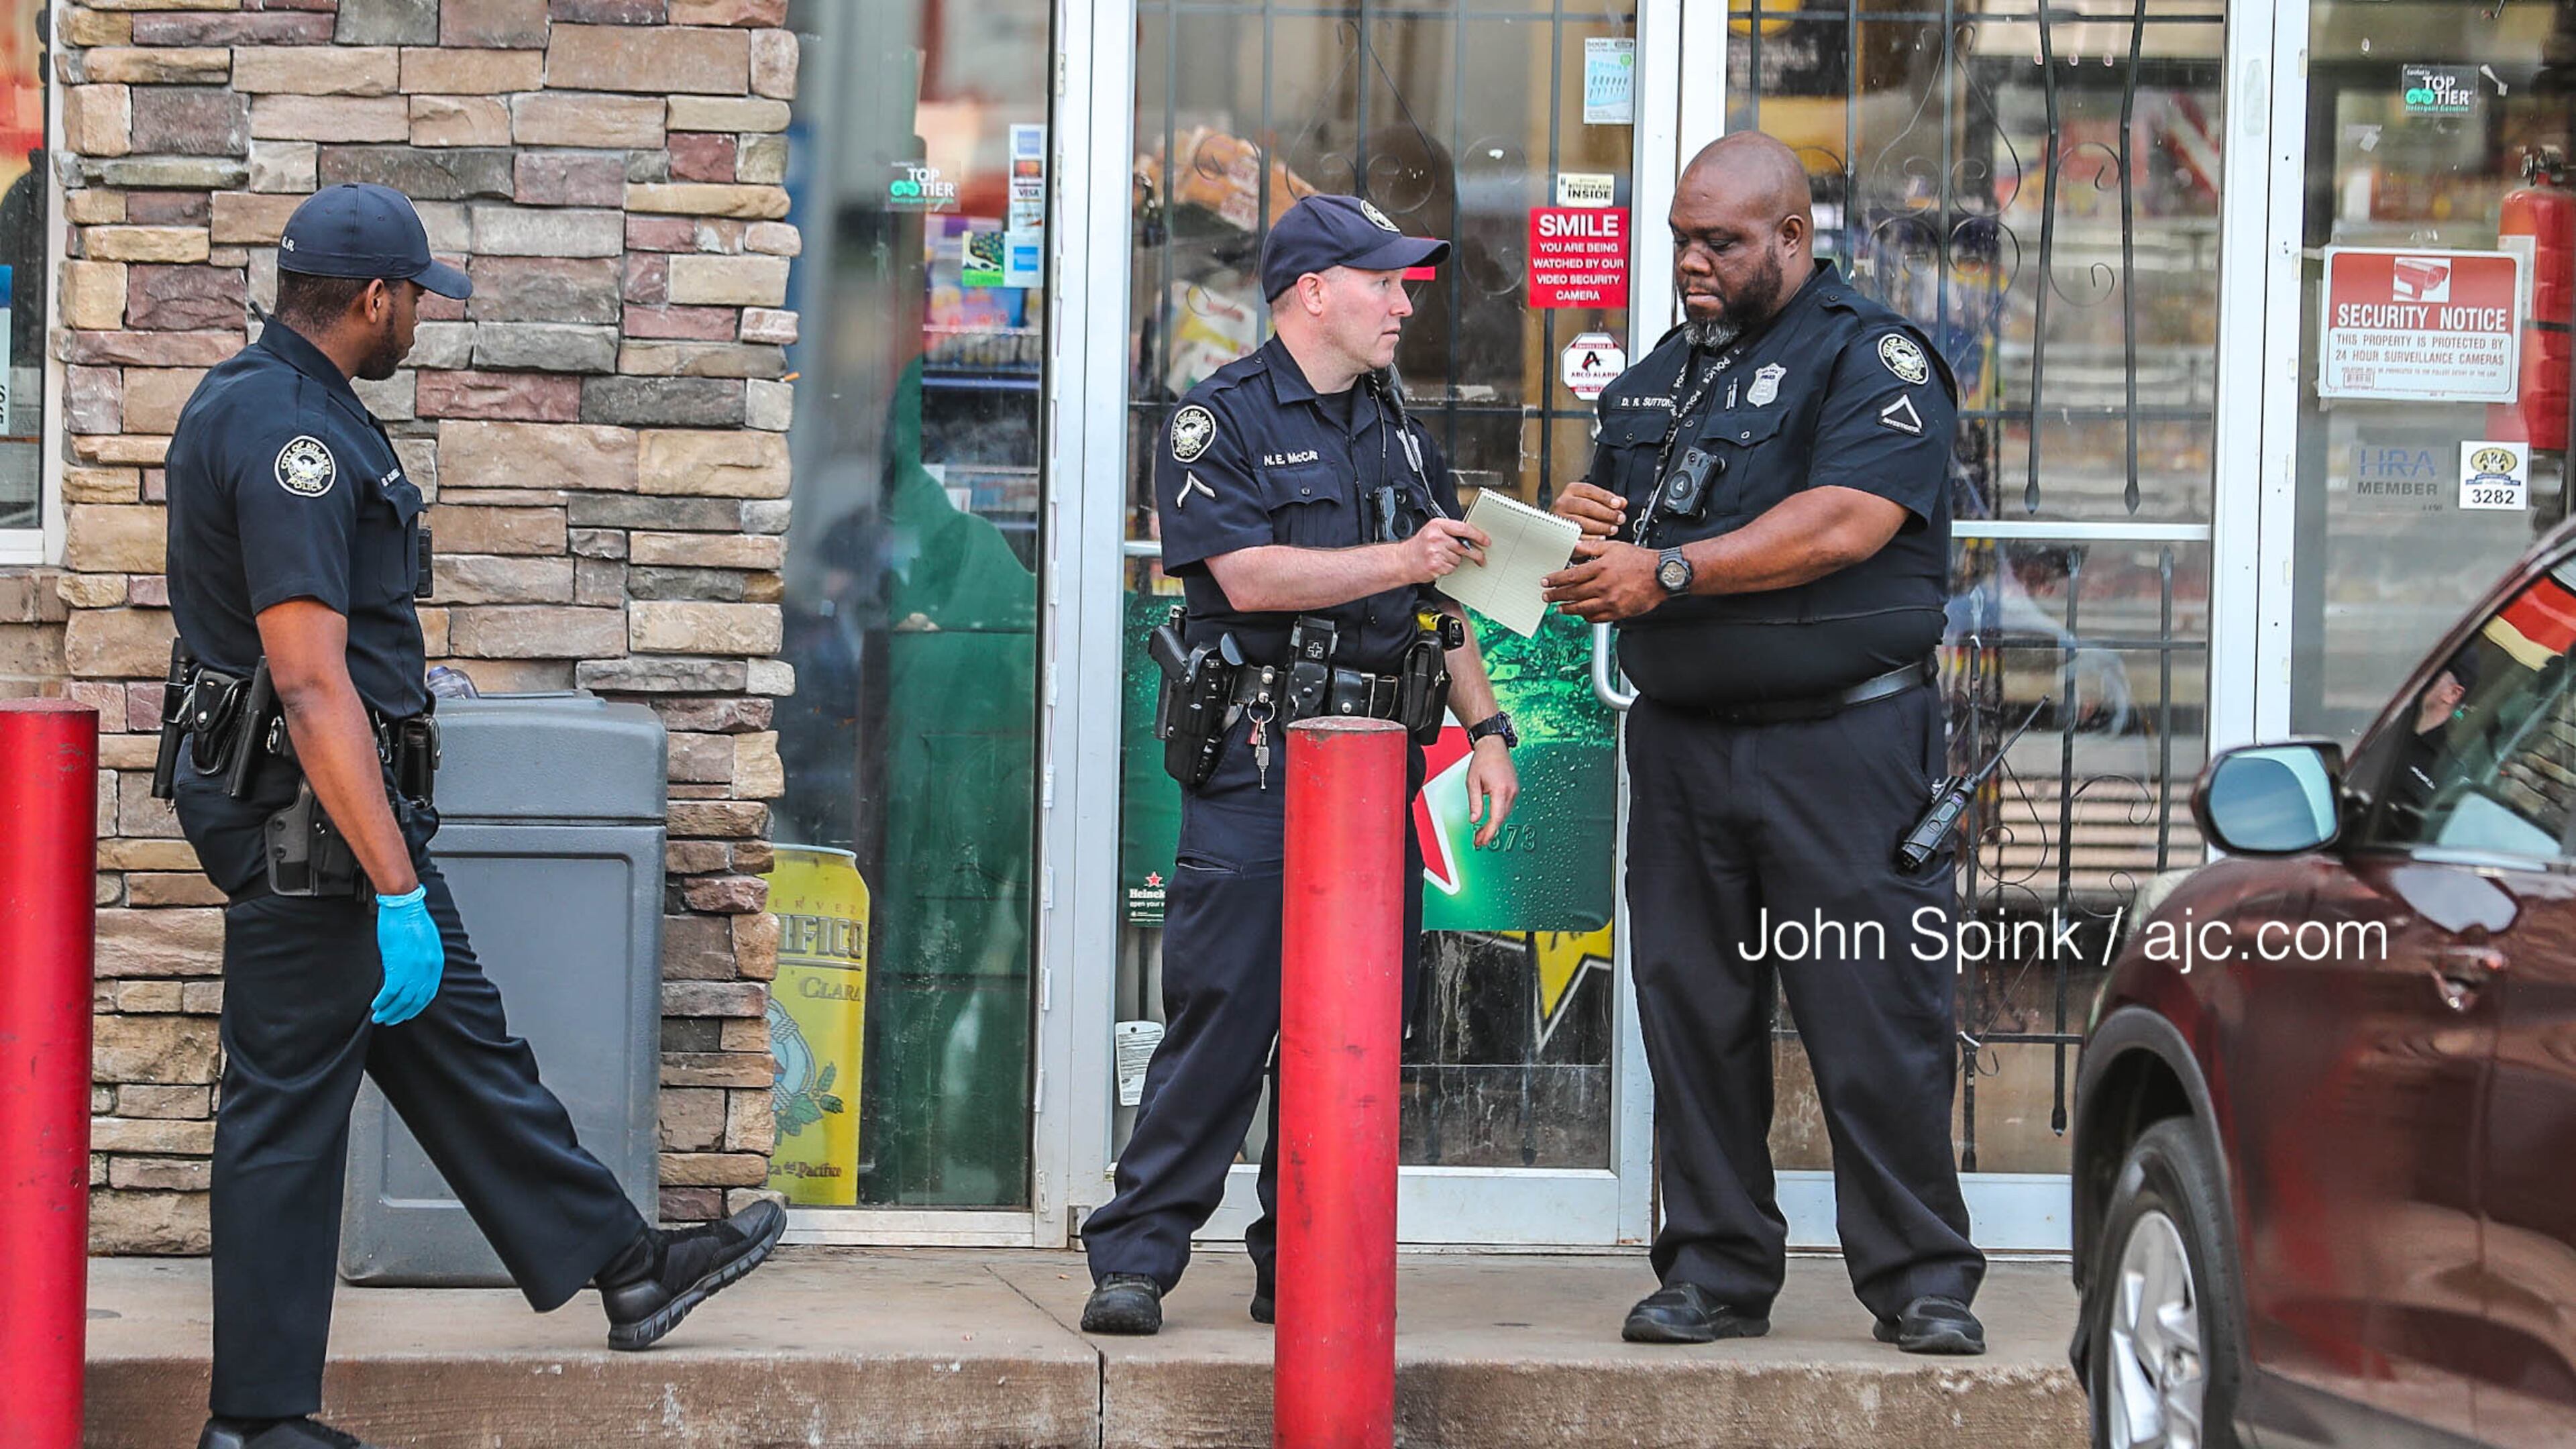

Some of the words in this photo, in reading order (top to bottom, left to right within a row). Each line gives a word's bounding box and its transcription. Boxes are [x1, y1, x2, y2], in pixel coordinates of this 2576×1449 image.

[2422, 75, 2456, 91] TOP
[2434, 89, 2469, 105] TIER
[907, 168, 939, 183] TOP
[920, 181, 954, 197] TIER
[1018, 189, 1040, 198] VISA
[1568, 190, 1611, 199] INSIDE
[1539, 214, 1619, 237] SMILE
[1540, 242, 1562, 253] YOU
[1564, 242, 1585, 253] ARE
[1587, 242, 1618, 253] BEING
[1533, 258, 1584, 269] WATCHED
[1585, 258, 1599, 269] BY
[1601, 258, 1624, 269] OUR
[1536, 274, 1568, 284] VIDEO
[1569, 274, 1620, 285] SECURITY
[1556, 290, 1600, 301] CAMERA
[2337, 303, 2429, 329] SECURITY
[2439, 306, 2507, 331] NOTICE
[2337, 333, 2357, 345] THIS
[2363, 334, 2412, 347] PROPERTY
[2417, 335, 2426, 347] IS
[2432, 336, 2486, 350] PROTECTED
[2491, 339, 2504, 350] BY
[2335, 349, 2347, 361] 24
[2352, 350, 2379, 362] HOUR
[2384, 350, 2453, 364] SURVEILLANCE
[2459, 352, 2504, 366] CAMERAS
[1703, 356, 1731, 384] POLICE
[1642, 396, 1671, 408] SUTTON
[281, 450, 292, 470] CITY
[291, 441, 305, 453] OF
[306, 442, 331, 476] ATLANTA
[2360, 449, 2437, 477] HRA
[286, 477, 323, 492] POLICE
[2357, 482, 2438, 496] MEMBER
[2472, 488, 2515, 504] 3282
[1129, 889, 1166, 899] Heinek
[774, 898, 865, 914] ERVEZ
[777, 912, 865, 959] IFICO
